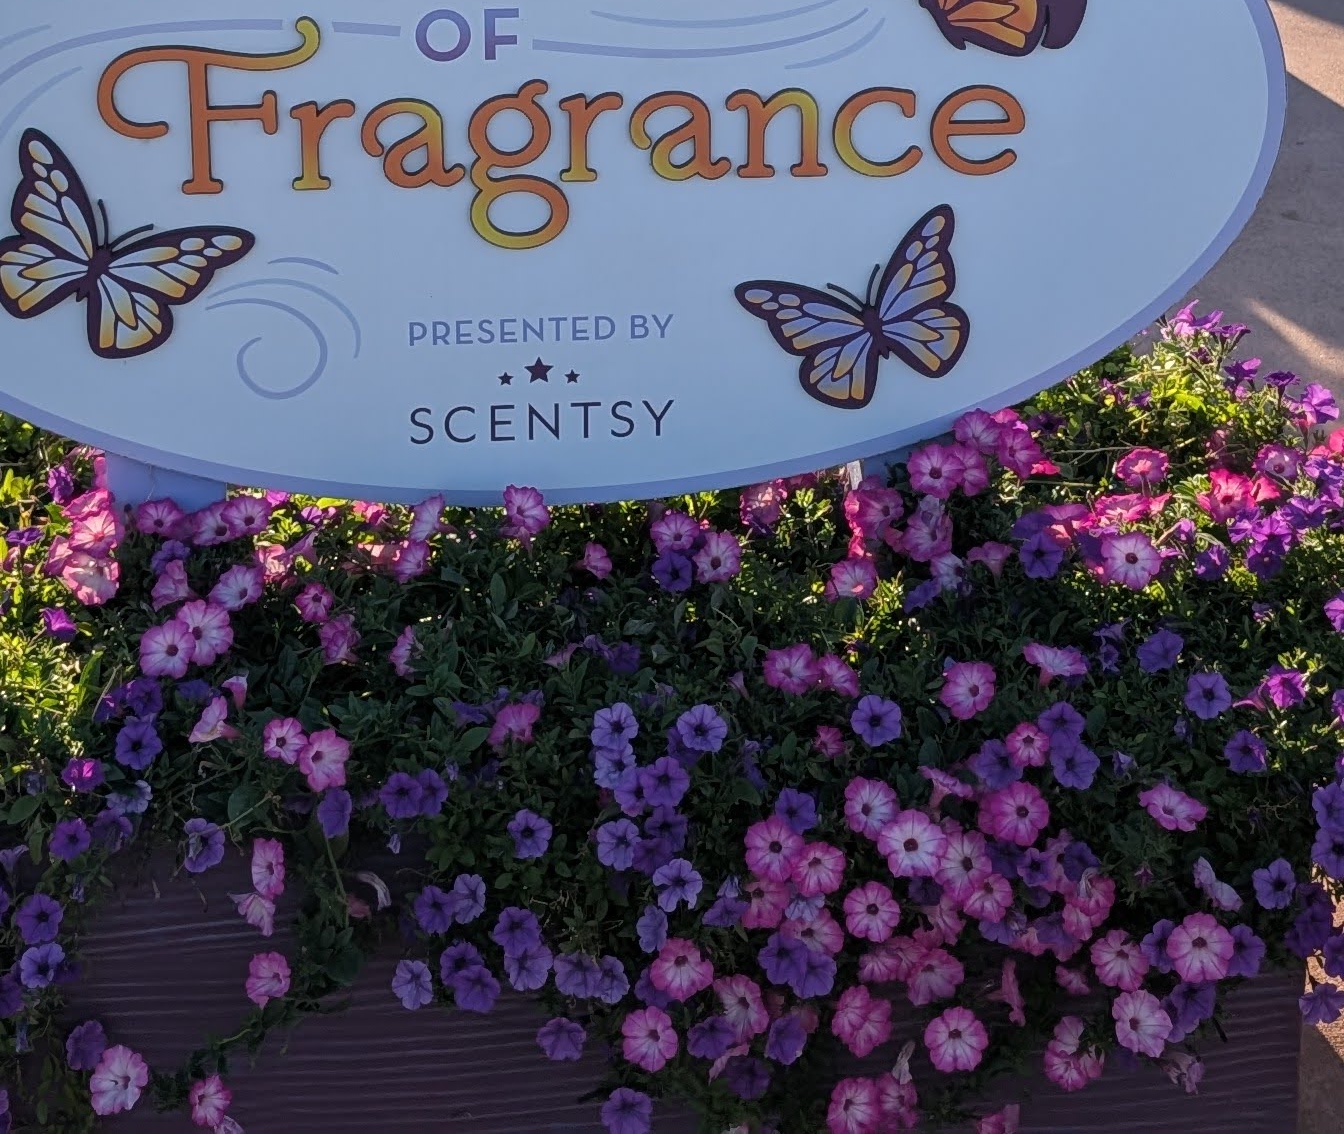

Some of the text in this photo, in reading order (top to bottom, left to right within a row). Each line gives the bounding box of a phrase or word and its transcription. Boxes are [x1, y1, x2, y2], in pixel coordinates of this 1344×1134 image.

[415, 7, 520, 63] OF
[96, 14, 1027, 251] Fragrance
[408, 313, 674, 347] PRESENTED BY
[410, 399, 675, 445] SCENTSY
